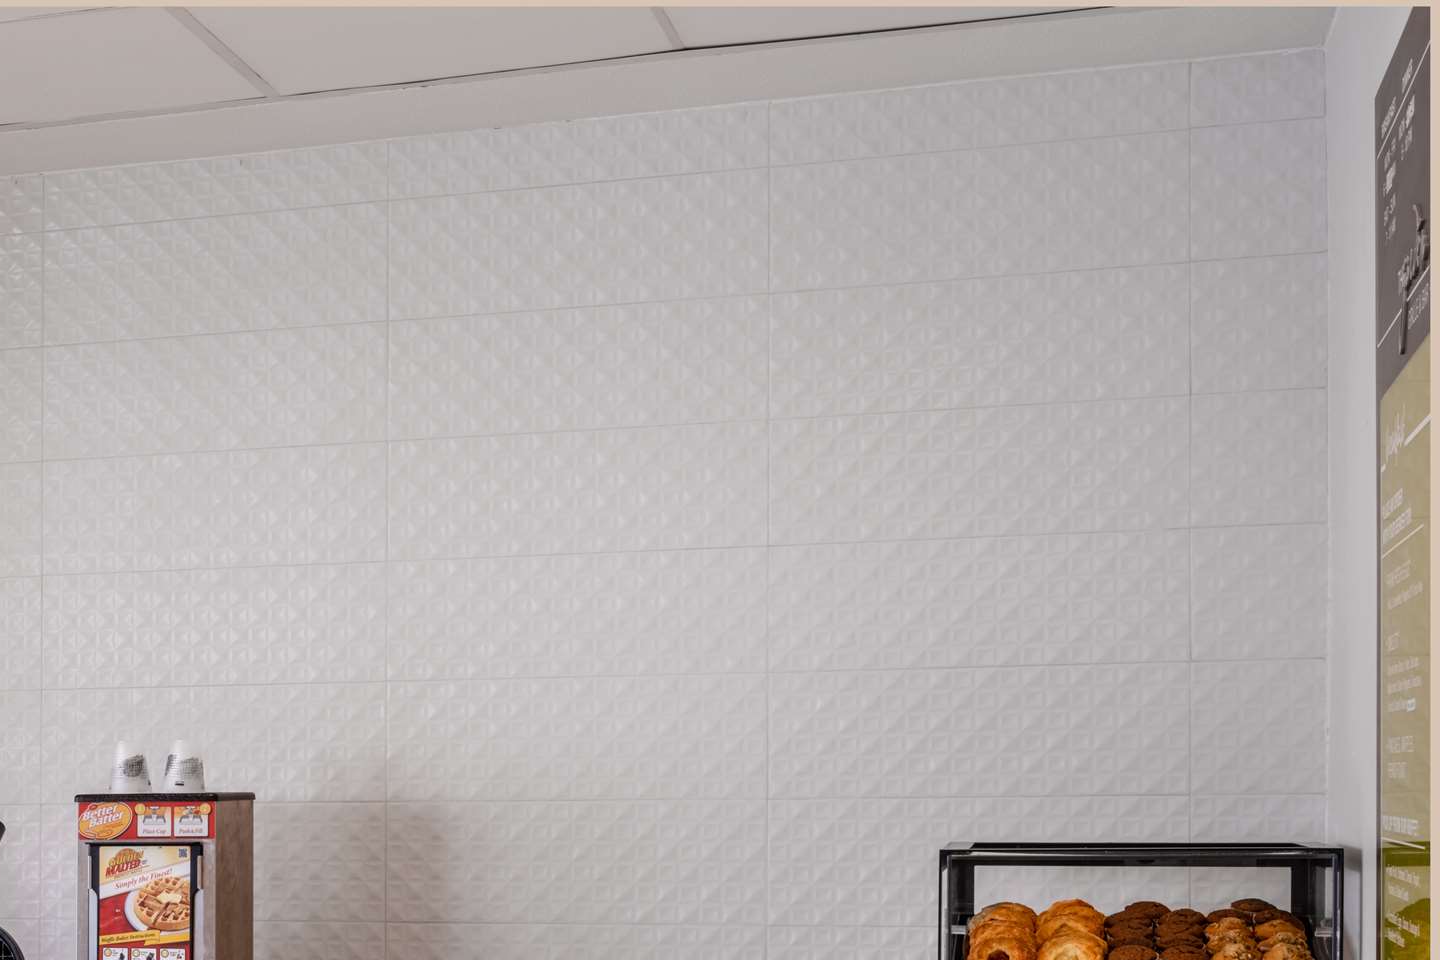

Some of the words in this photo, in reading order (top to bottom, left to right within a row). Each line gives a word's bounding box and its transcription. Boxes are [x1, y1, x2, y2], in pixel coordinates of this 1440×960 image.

[89, 811, 123, 829] Batter
[115, 879, 137, 889] Simply
[138, 874, 149, 882] the
